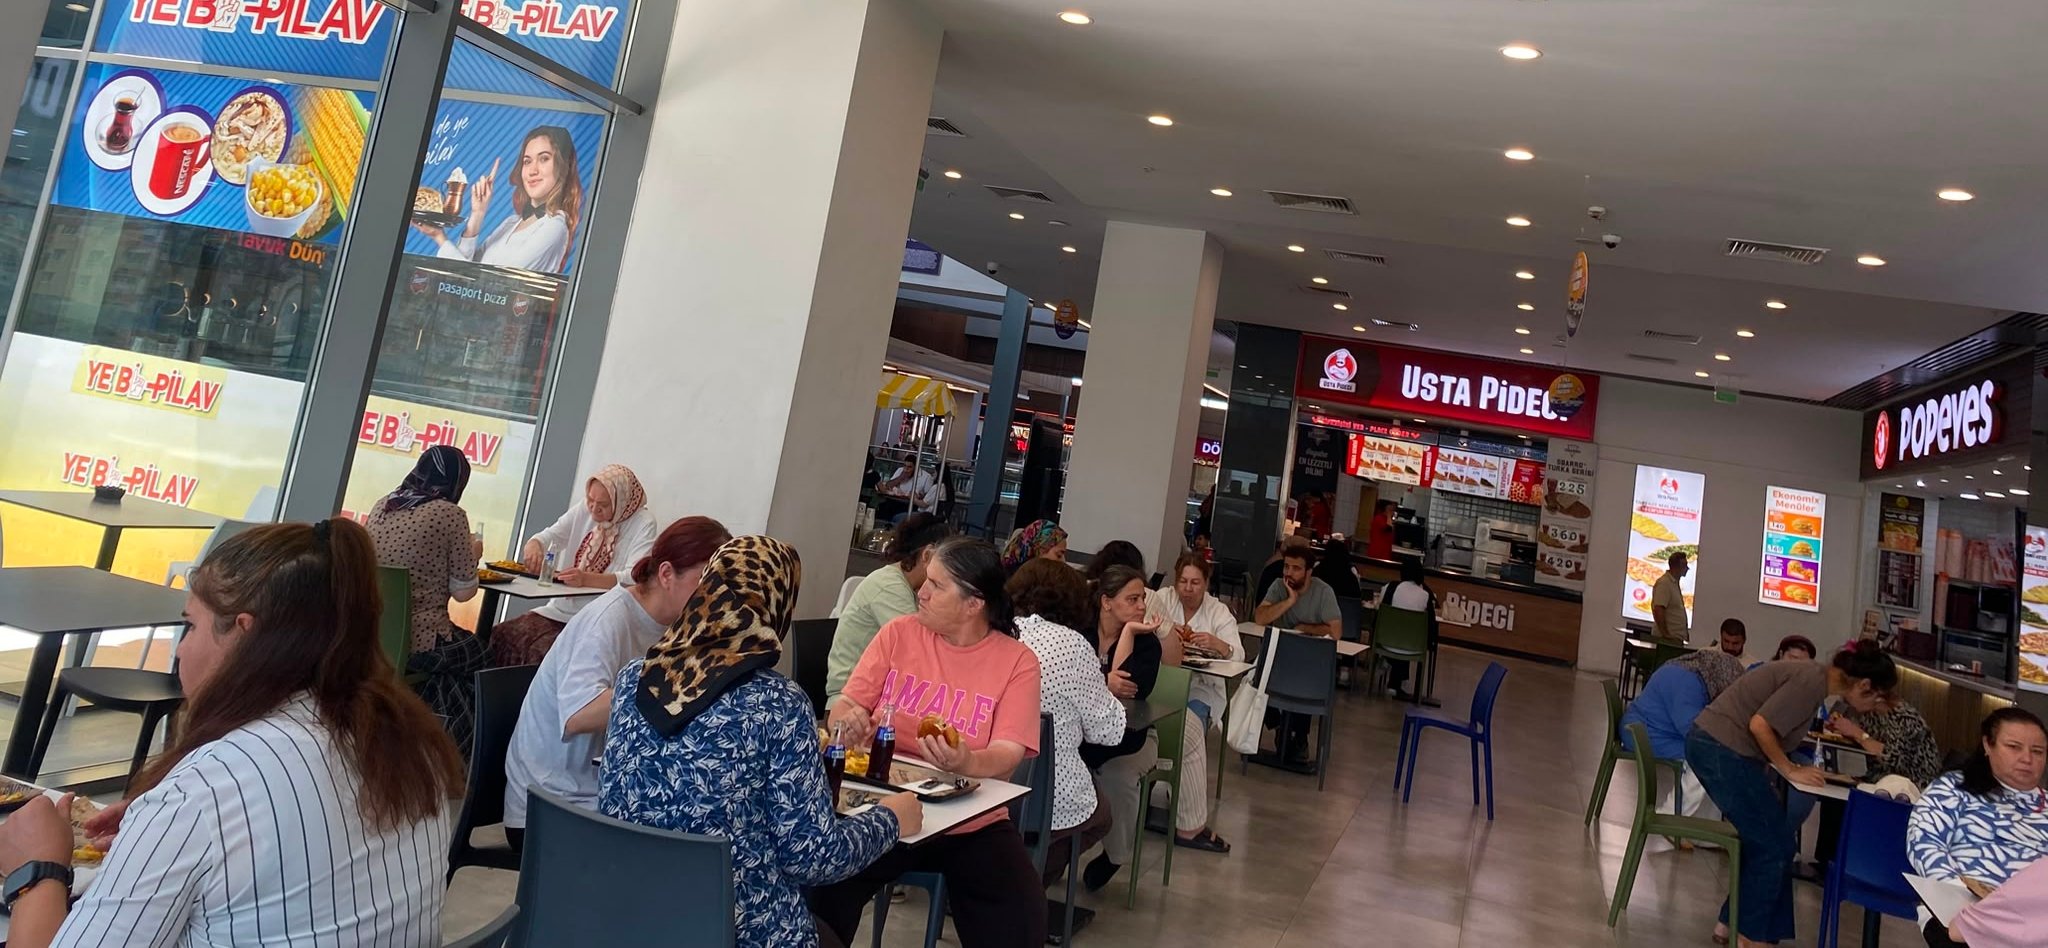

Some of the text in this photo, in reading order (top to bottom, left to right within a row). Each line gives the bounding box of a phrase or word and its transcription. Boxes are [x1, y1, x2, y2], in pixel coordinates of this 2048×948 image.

[437, 281, 483, 300] pasaport
[86, 360, 116, 391] YE
[1401, 364, 1472, 408] USTA
[62, 452, 92, 485] YE
[1559, 481, 1585, 495] 225
[1772, 489, 1820, 504] Ekonomix
[1775, 499, 1816, 513] Menüler
[1551, 527, 1578, 542] 360
[1546, 556, 1573, 569] 420
